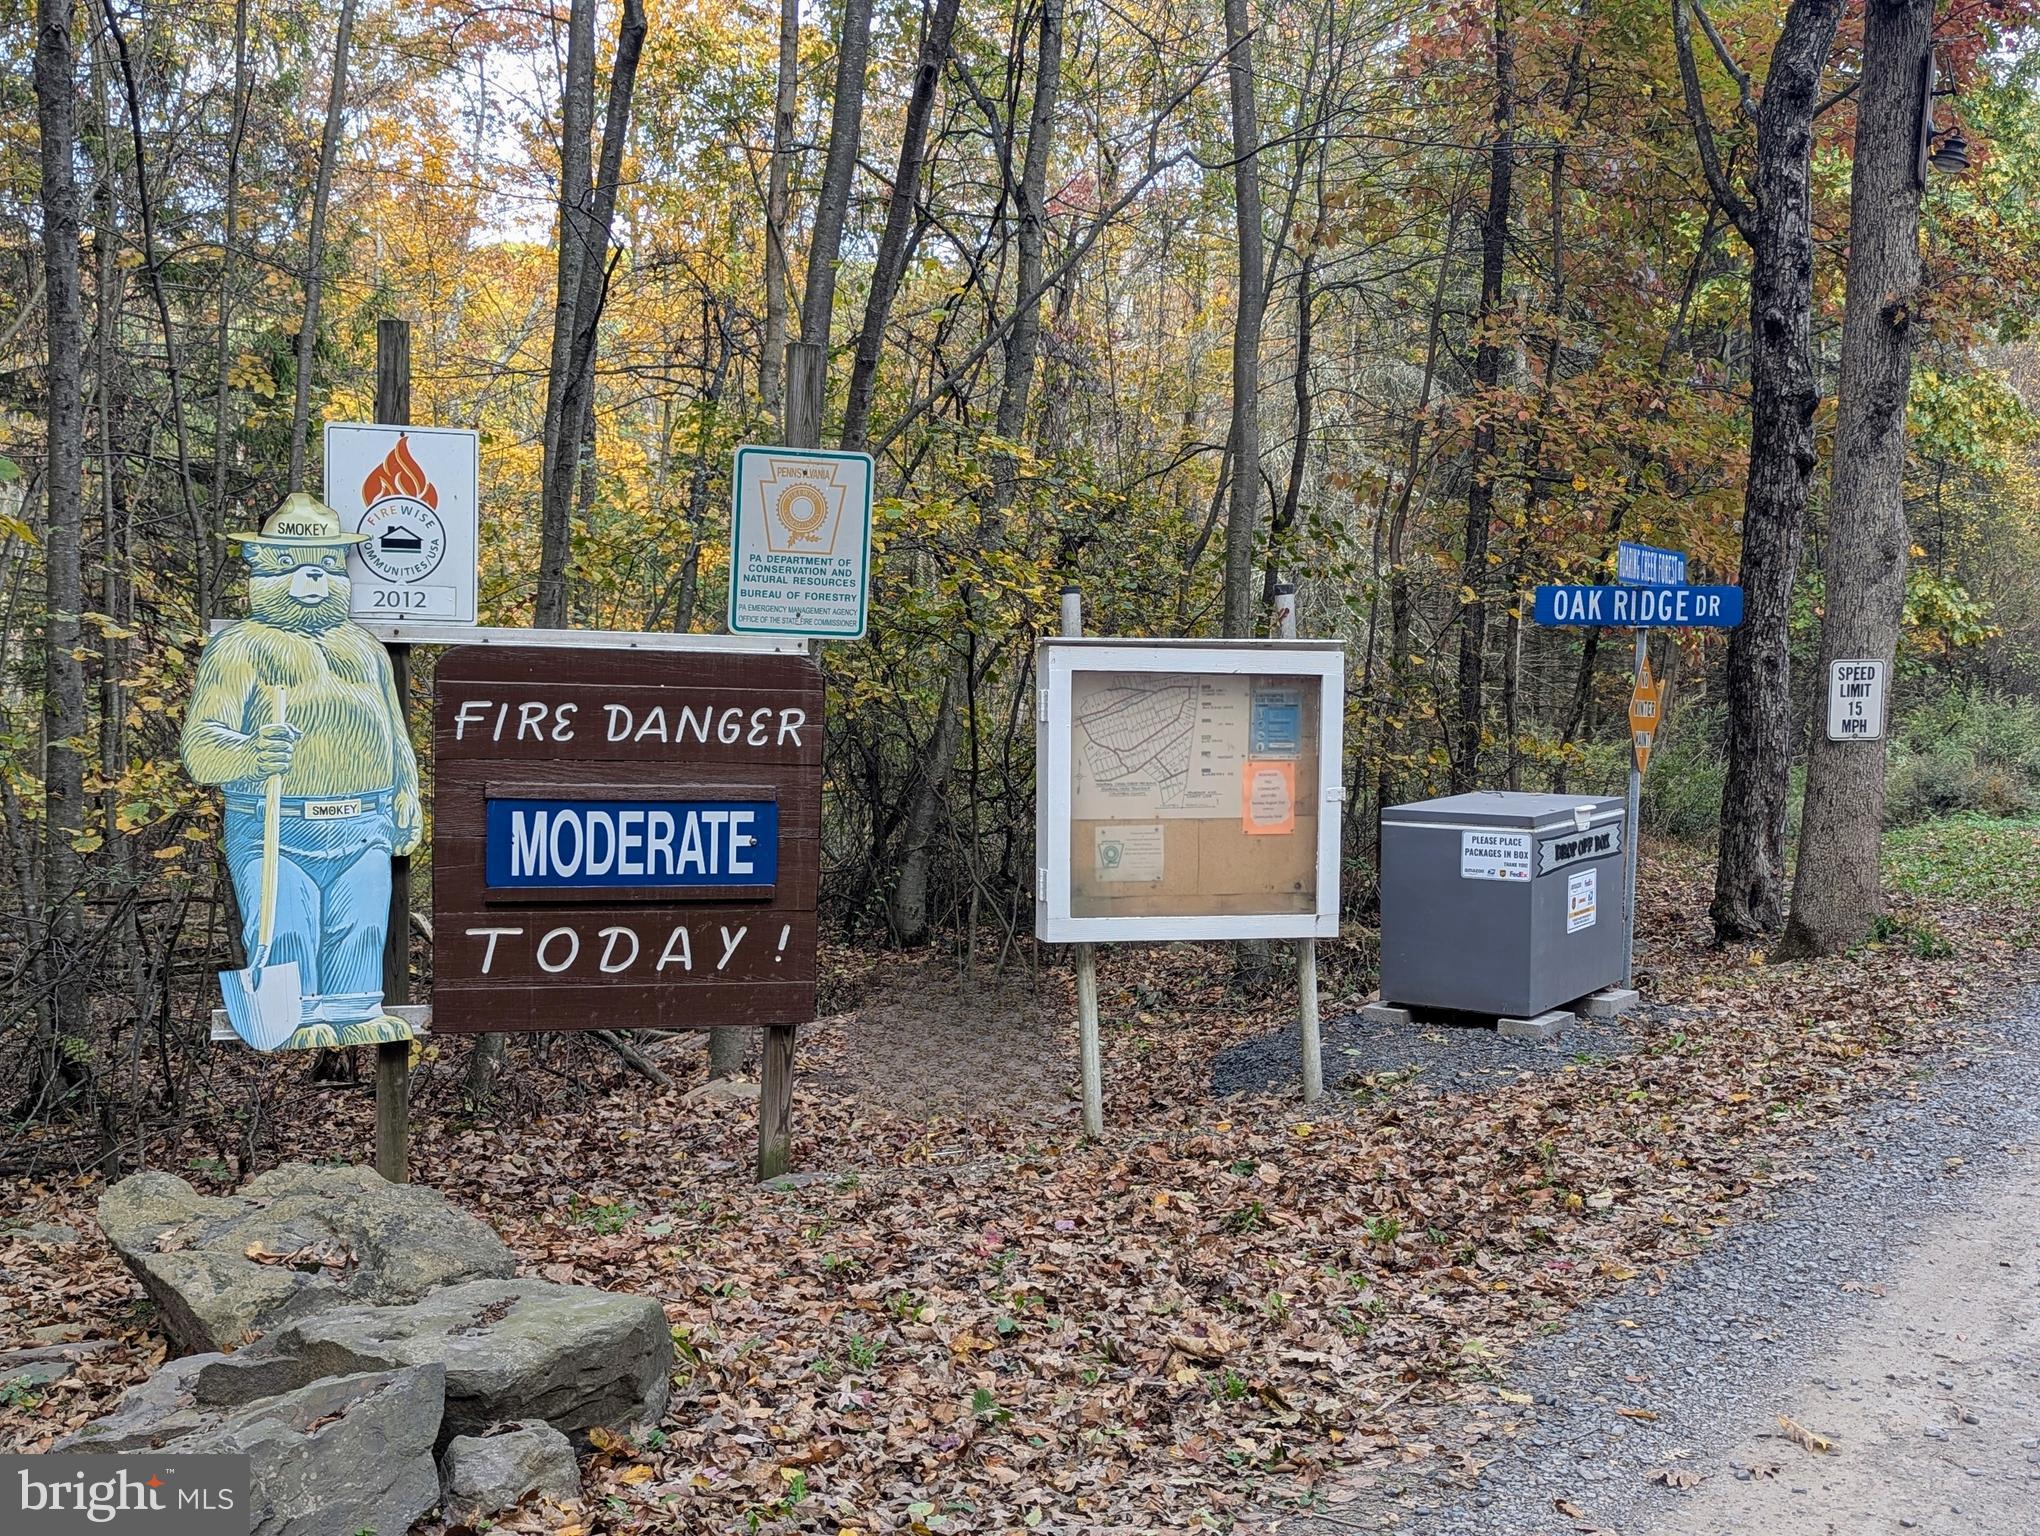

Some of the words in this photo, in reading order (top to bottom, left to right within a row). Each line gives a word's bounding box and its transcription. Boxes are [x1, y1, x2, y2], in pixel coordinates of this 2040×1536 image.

[777, 467, 830, 480] PENNSYLVANIA
[367, 505, 435, 529] FIREWISE
[277, 522, 328, 536] SMOKEY
[364, 535, 439, 577] OMMUNITIES/USA
[749, 554, 762, 563] PA
[767, 554, 834, 567] DEPARTMENT
[838, 558, 852, 567] OF
[748, 564, 827, 576] CONSERVATION
[831, 568, 852, 578] AND
[1641, 549, 1658, 583] CREEK
[1658, 553, 1678, 585] FOREST
[743, 574, 788, 585] NATURAL
[793, 577, 856, 588] RESOURCES
[373, 590, 426, 608] 2012
[740, 588, 782, 599] BUREAU
[786, 591, 800, 600] OF
[805, 592, 857, 603] FORESTRY
[739, 603, 747, 611] PA
[748, 604, 787, 613] EMERGENCY
[788, 606, 832, 615] MANAGEMENT
[833, 608, 857, 617] AGENCY
[1553, 590, 1603, 621] OAK
[1614, 590, 1689, 622] RIDGE
[1695, 595, 1721, 617] DR
[738, 615, 759, 623] OFFICE
[760, 615, 768, 624] OF
[770, 616, 781, 624] THE
[781, 616, 800, 625] STATE
[801, 617, 812, 626] FIRE
[813, 618, 857, 628] COMMISSIONER
[1838, 666, 1875, 681] SPEED
[1840, 684, 1872, 698] LIMIT
[1849, 701, 1862, 716] 15
[454, 700, 578, 742] FIRE
[603, 703, 806, 747] DANGER
[1841, 719, 1867, 733] MPH
[312, 804, 358, 816] SMOKEY
[511, 809, 755, 878] MODERATE
[1471, 835, 1498, 846] PLEASE
[1499, 838, 1522, 847] PLACE
[1464, 847, 1502, 858] PACKAGES
[1503, 850, 1512, 859] IN
[1513, 850, 1529, 860] BOX
[1554, 841, 1578, 861] DROP
[1509, 870, 1528, 878] FedEx
